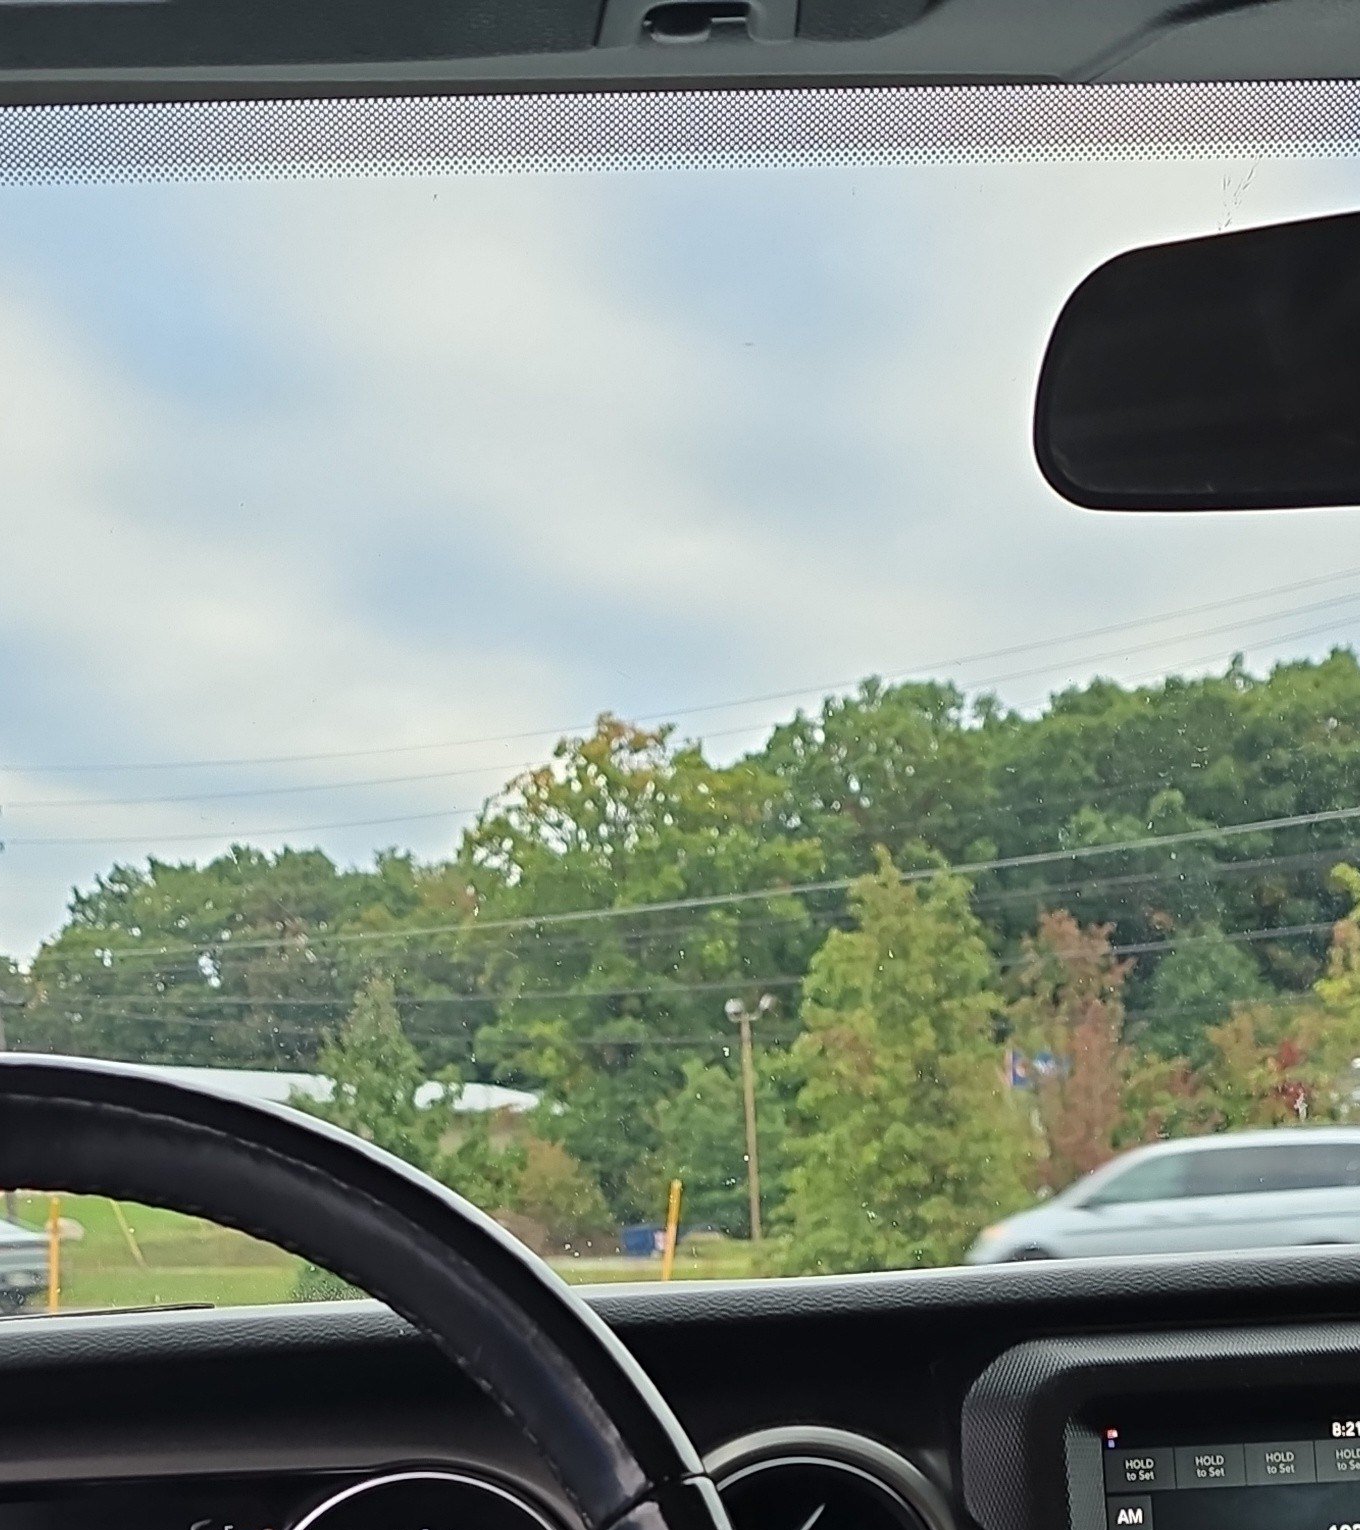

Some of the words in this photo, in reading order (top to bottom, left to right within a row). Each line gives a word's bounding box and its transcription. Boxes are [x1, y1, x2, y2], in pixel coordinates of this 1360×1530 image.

[1195, 1455, 1224, 1467] HOLD
[1265, 1452, 1294, 1463] HOLD
[1125, 1459, 1154, 1470] HOLD
[1267, 1464, 1276, 1474] to
[1278, 1463, 1295, 1474] Set
[1337, 1461, 1346, 1471] to
[1126, 1471, 1135, 1481] to
[1137, 1470, 1154, 1481] Set
[1196, 1467, 1206, 1478] to
[1208, 1466, 1225, 1478] Set
[1117, 1509, 1143, 1525] AM
